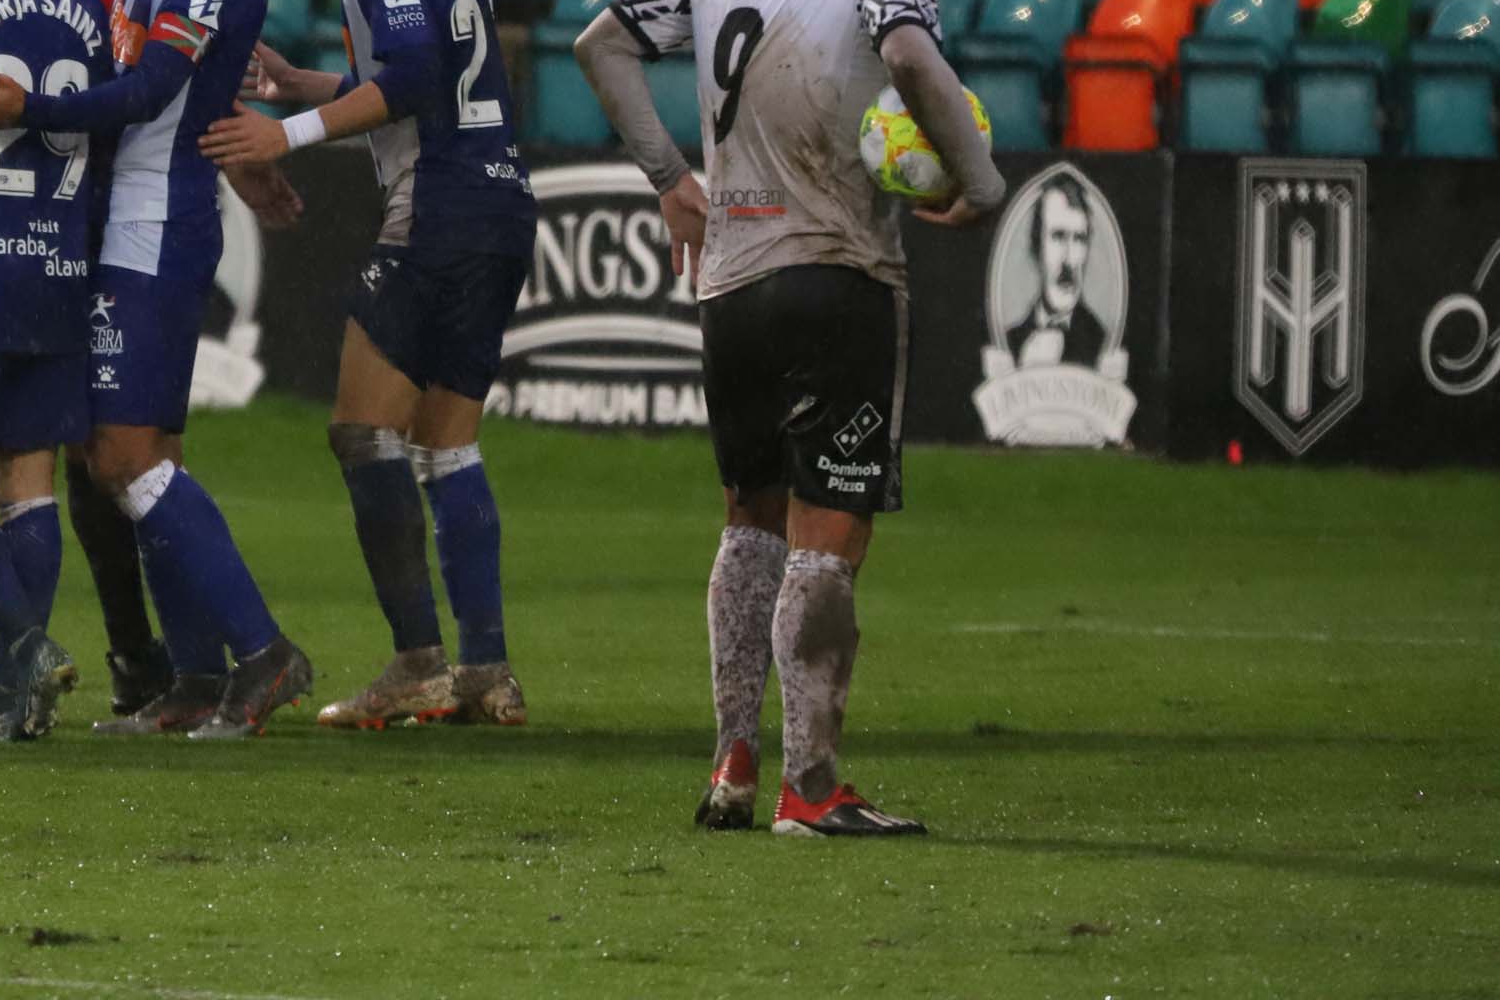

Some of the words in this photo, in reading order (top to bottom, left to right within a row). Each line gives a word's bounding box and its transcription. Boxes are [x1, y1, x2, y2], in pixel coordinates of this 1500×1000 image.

[387, 11, 425, 26] ELEYCO
[713, 6, 764, 145] 9
[28, 219, 60, 234] visit
[817, 454, 883, 477] Domino's
[826, 475, 867, 493] Pizza
